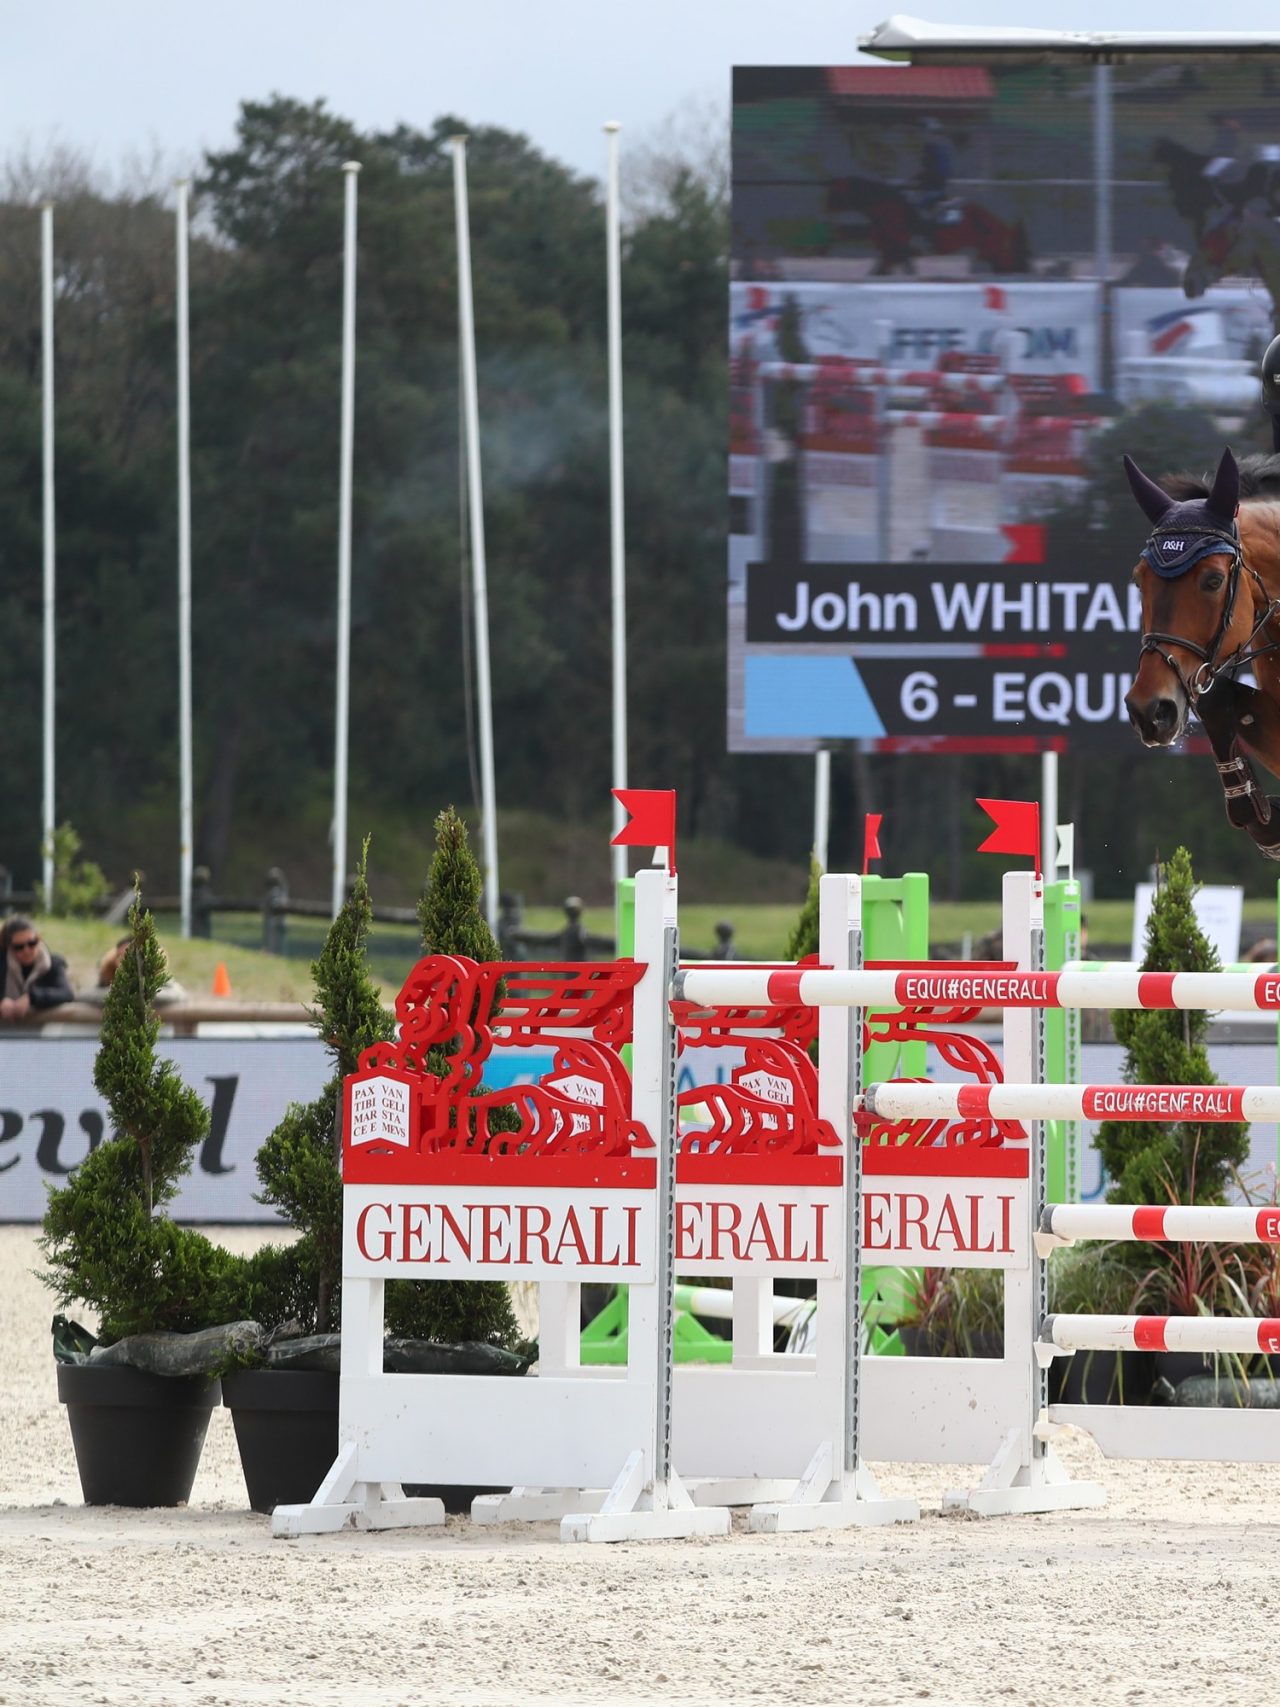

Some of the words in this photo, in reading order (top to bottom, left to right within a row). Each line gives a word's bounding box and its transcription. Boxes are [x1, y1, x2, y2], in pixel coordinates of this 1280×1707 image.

[1162, 540, 1185, 551] D&H
[776, 582, 917, 632] John
[900, 671, 939, 723] 6
[992, 672, 1132, 725] EQUI
[905, 978, 1048, 1001] EQUI#GENERALI
[382, 1084, 403, 1099] VAN
[576, 1083, 597, 1098] VAN
[768, 1077, 787, 1091] VAN
[355, 1085, 375, 1100] PAX
[768, 1089, 789, 1105] GELI
[355, 1098, 376, 1112] TIBI
[382, 1097, 405, 1113] GELI
[354, 1110, 377, 1125] MAR
[382, 1110, 401, 1124] STA
[353, 1125, 367, 1137] CE
[371, 1122, 377, 1132] E
[382, 1122, 406, 1137] MEVS
[862, 1191, 1016, 1254] ERALI
[356, 1202, 642, 1267] GENERALI
[675, 1201, 829, 1263] ERALI
